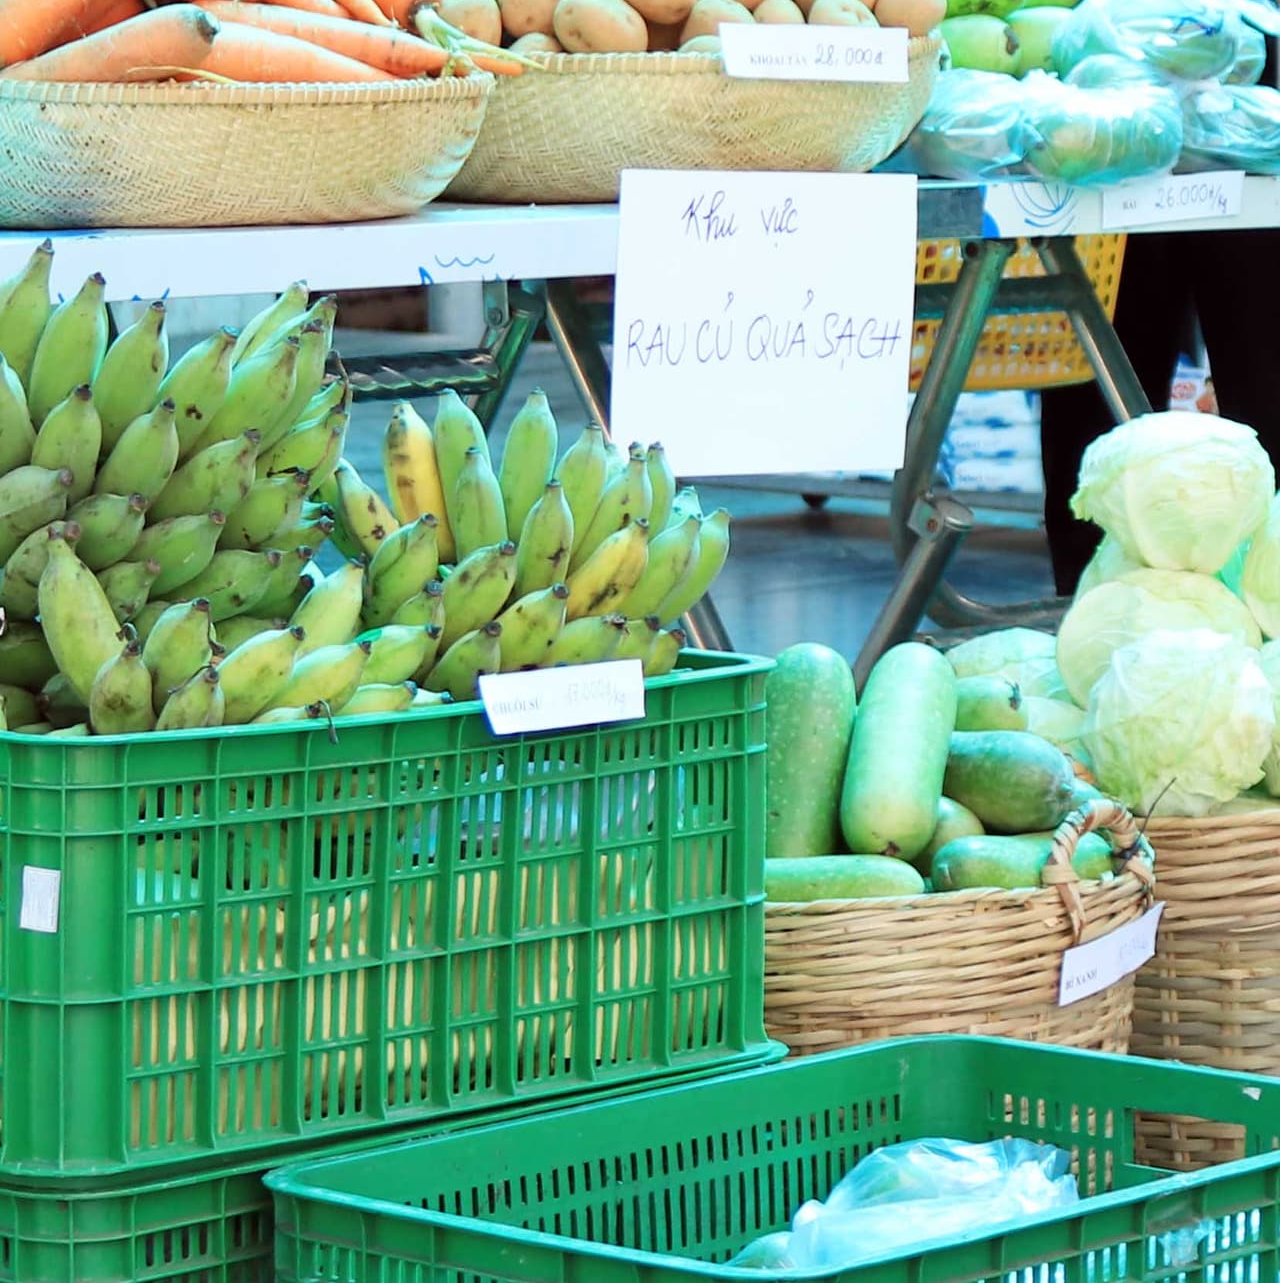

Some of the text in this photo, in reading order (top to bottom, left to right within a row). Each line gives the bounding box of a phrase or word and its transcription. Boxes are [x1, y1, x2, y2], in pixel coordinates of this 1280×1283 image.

[681, 191, 738, 243] Khu
[627, 289, 901, 370] RAU CỦ QUẢ SẠCH
